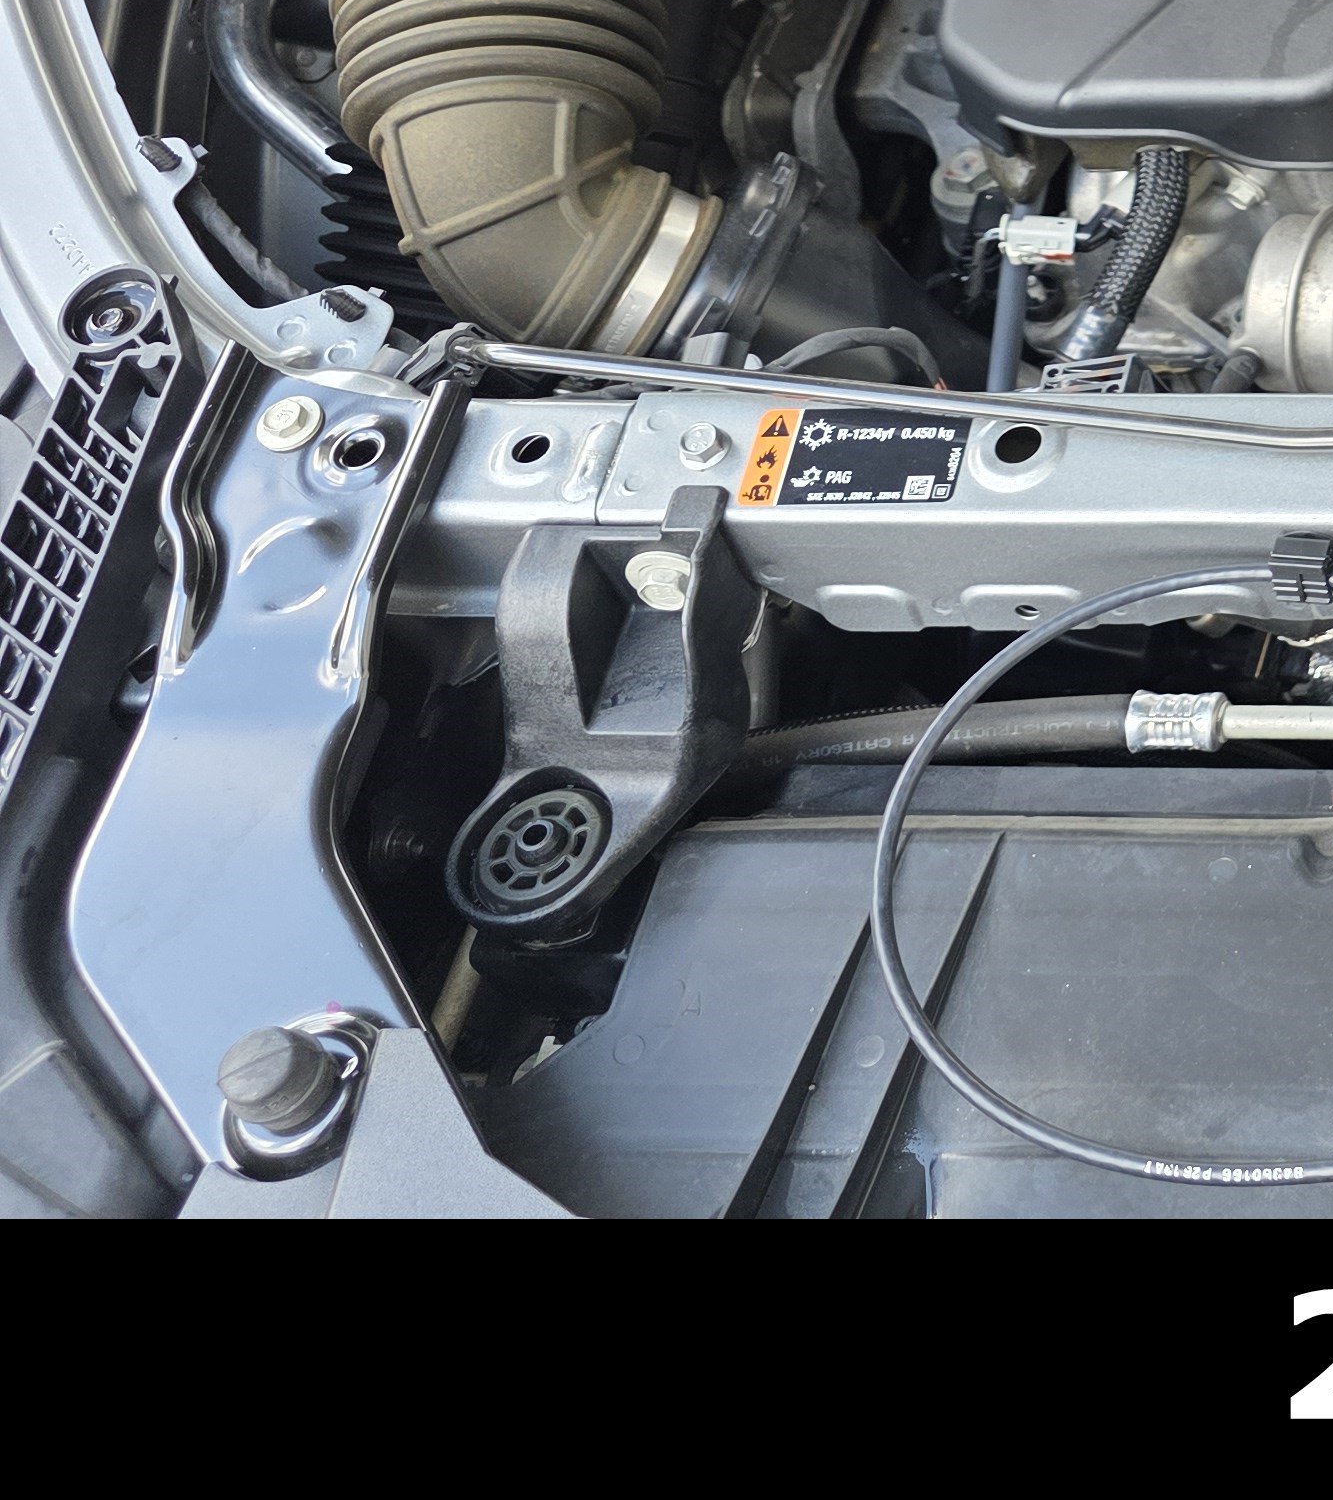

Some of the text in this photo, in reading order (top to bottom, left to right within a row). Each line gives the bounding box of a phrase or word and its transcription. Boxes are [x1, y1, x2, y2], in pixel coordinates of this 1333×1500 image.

[836, 426, 955, 443] R-1234yf 0.450 kg
[824, 470, 852, 485] PAG
[796, 737, 894, 761] CATEGORY
